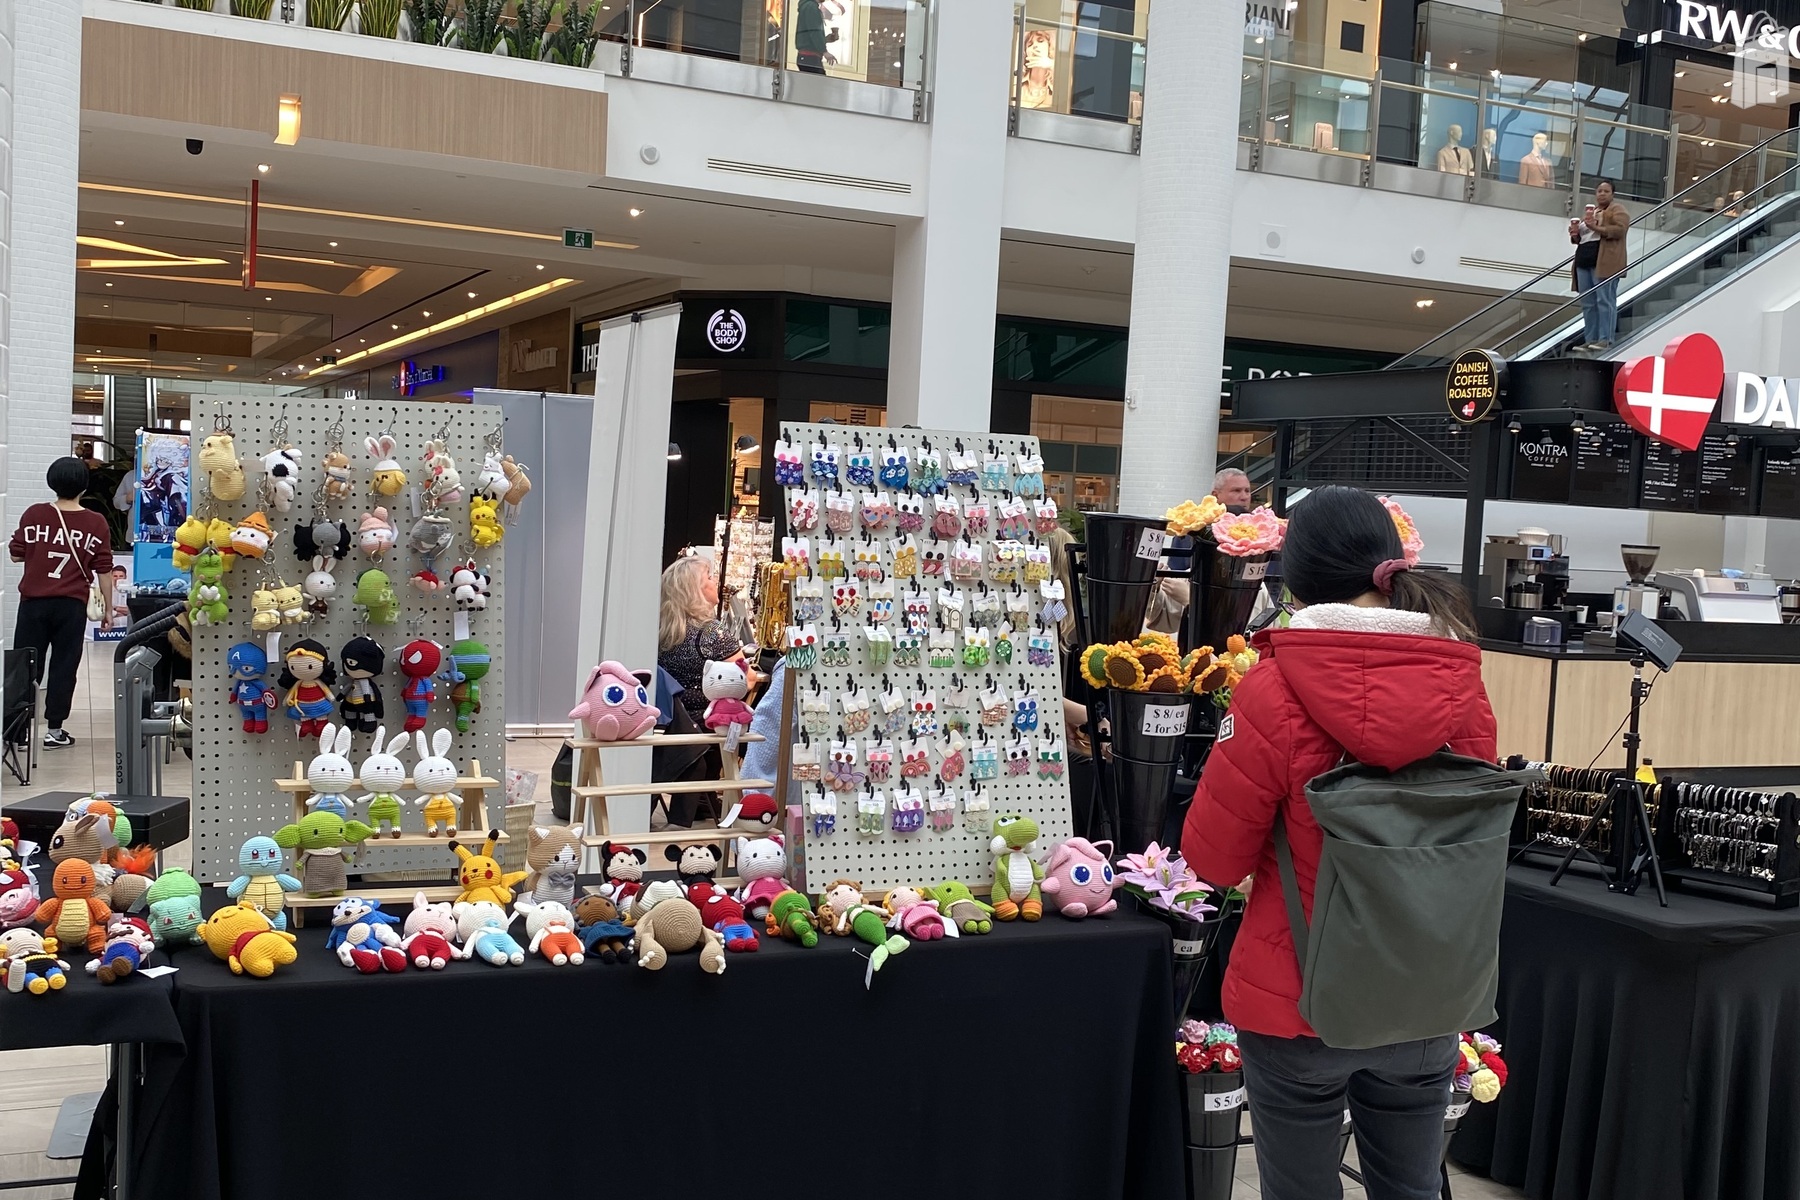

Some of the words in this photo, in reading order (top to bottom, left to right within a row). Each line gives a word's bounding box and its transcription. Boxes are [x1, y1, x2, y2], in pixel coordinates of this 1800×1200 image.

[715, 329, 739, 337] BODY
[1456, 362, 1489, 374] DANISH
[1454, 375, 1489, 386] COFFEE
[1448, 387, 1493, 399] ROASTERS
[1734, 371, 1800, 429] DA
[1520, 442, 1568, 457] KONTRA
[47, 551, 71, 579] 7
[1144, 722, 1151, 733] 2
[1154, 723, 1172, 734] for
[1180, 945, 1193, 953] ea
